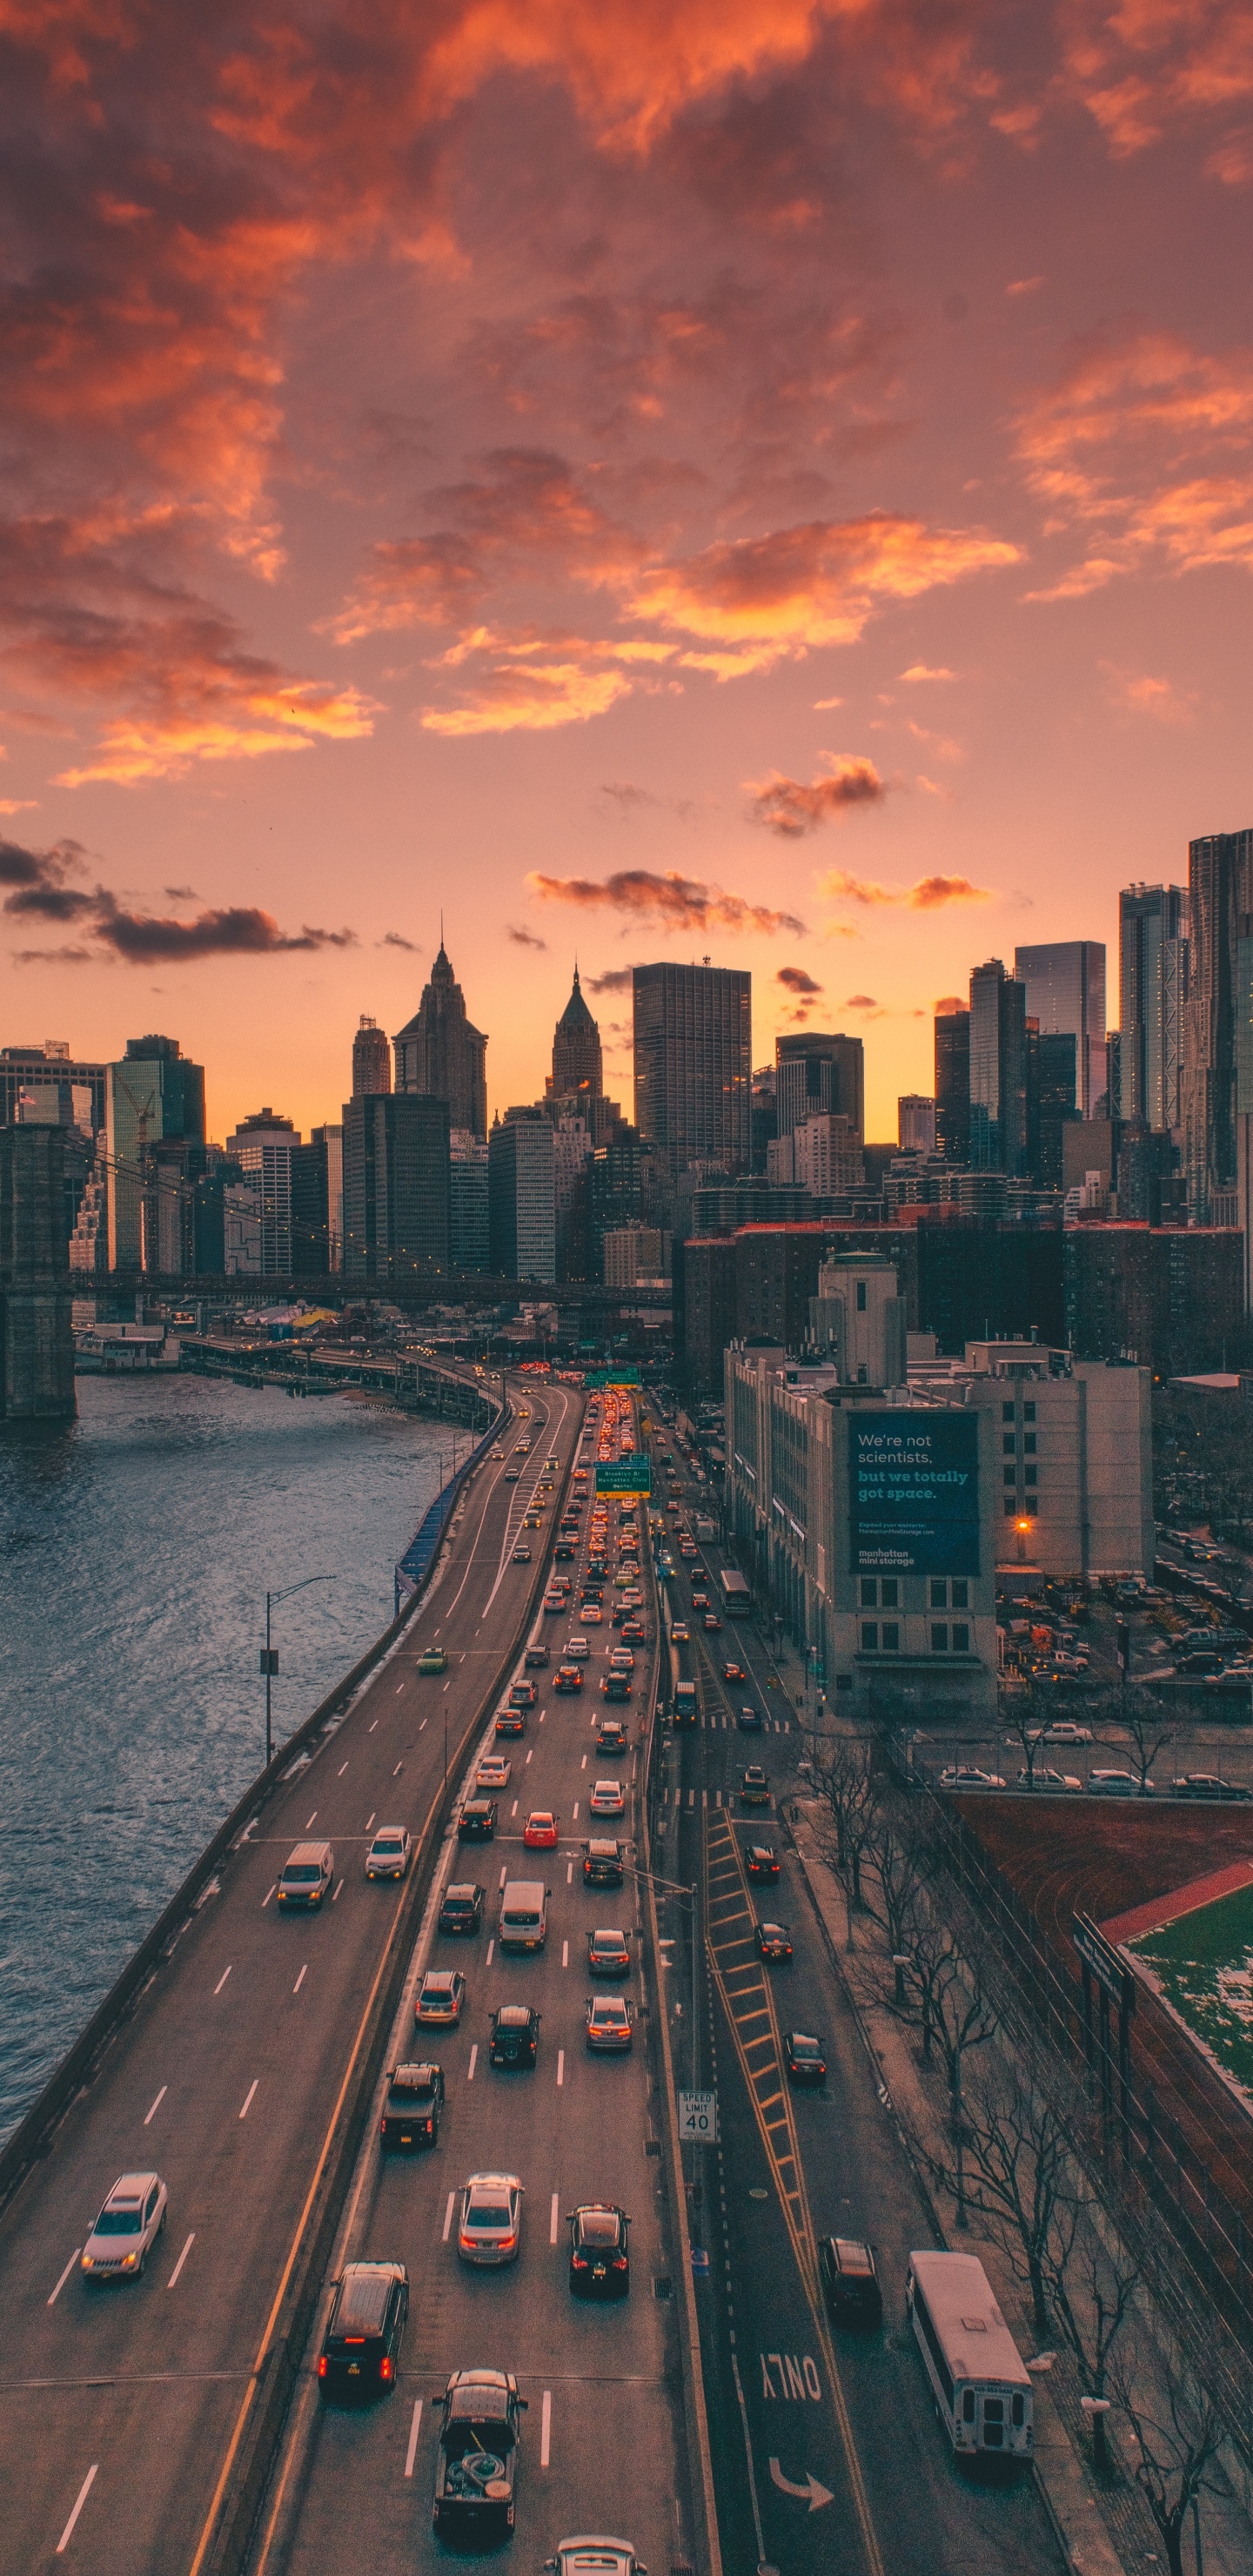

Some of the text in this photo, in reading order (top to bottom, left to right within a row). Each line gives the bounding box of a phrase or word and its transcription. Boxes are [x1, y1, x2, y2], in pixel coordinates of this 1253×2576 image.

[858, 1434, 931, 1446] We're not
[858, 1451, 932, 1464] scientists,
[858, 1471, 968, 1486] but we totally
[858, 1488, 937, 1502] got space.
[859, 1547, 908, 1558] manhattan
[879, 1558, 915, 1566] storage
[683, 2093, 711, 2103] SPEED
[686, 2103, 708, 2112] LIMIT
[686, 2115, 708, 2130] 40
[760, 2353, 821, 2401] ONLY
